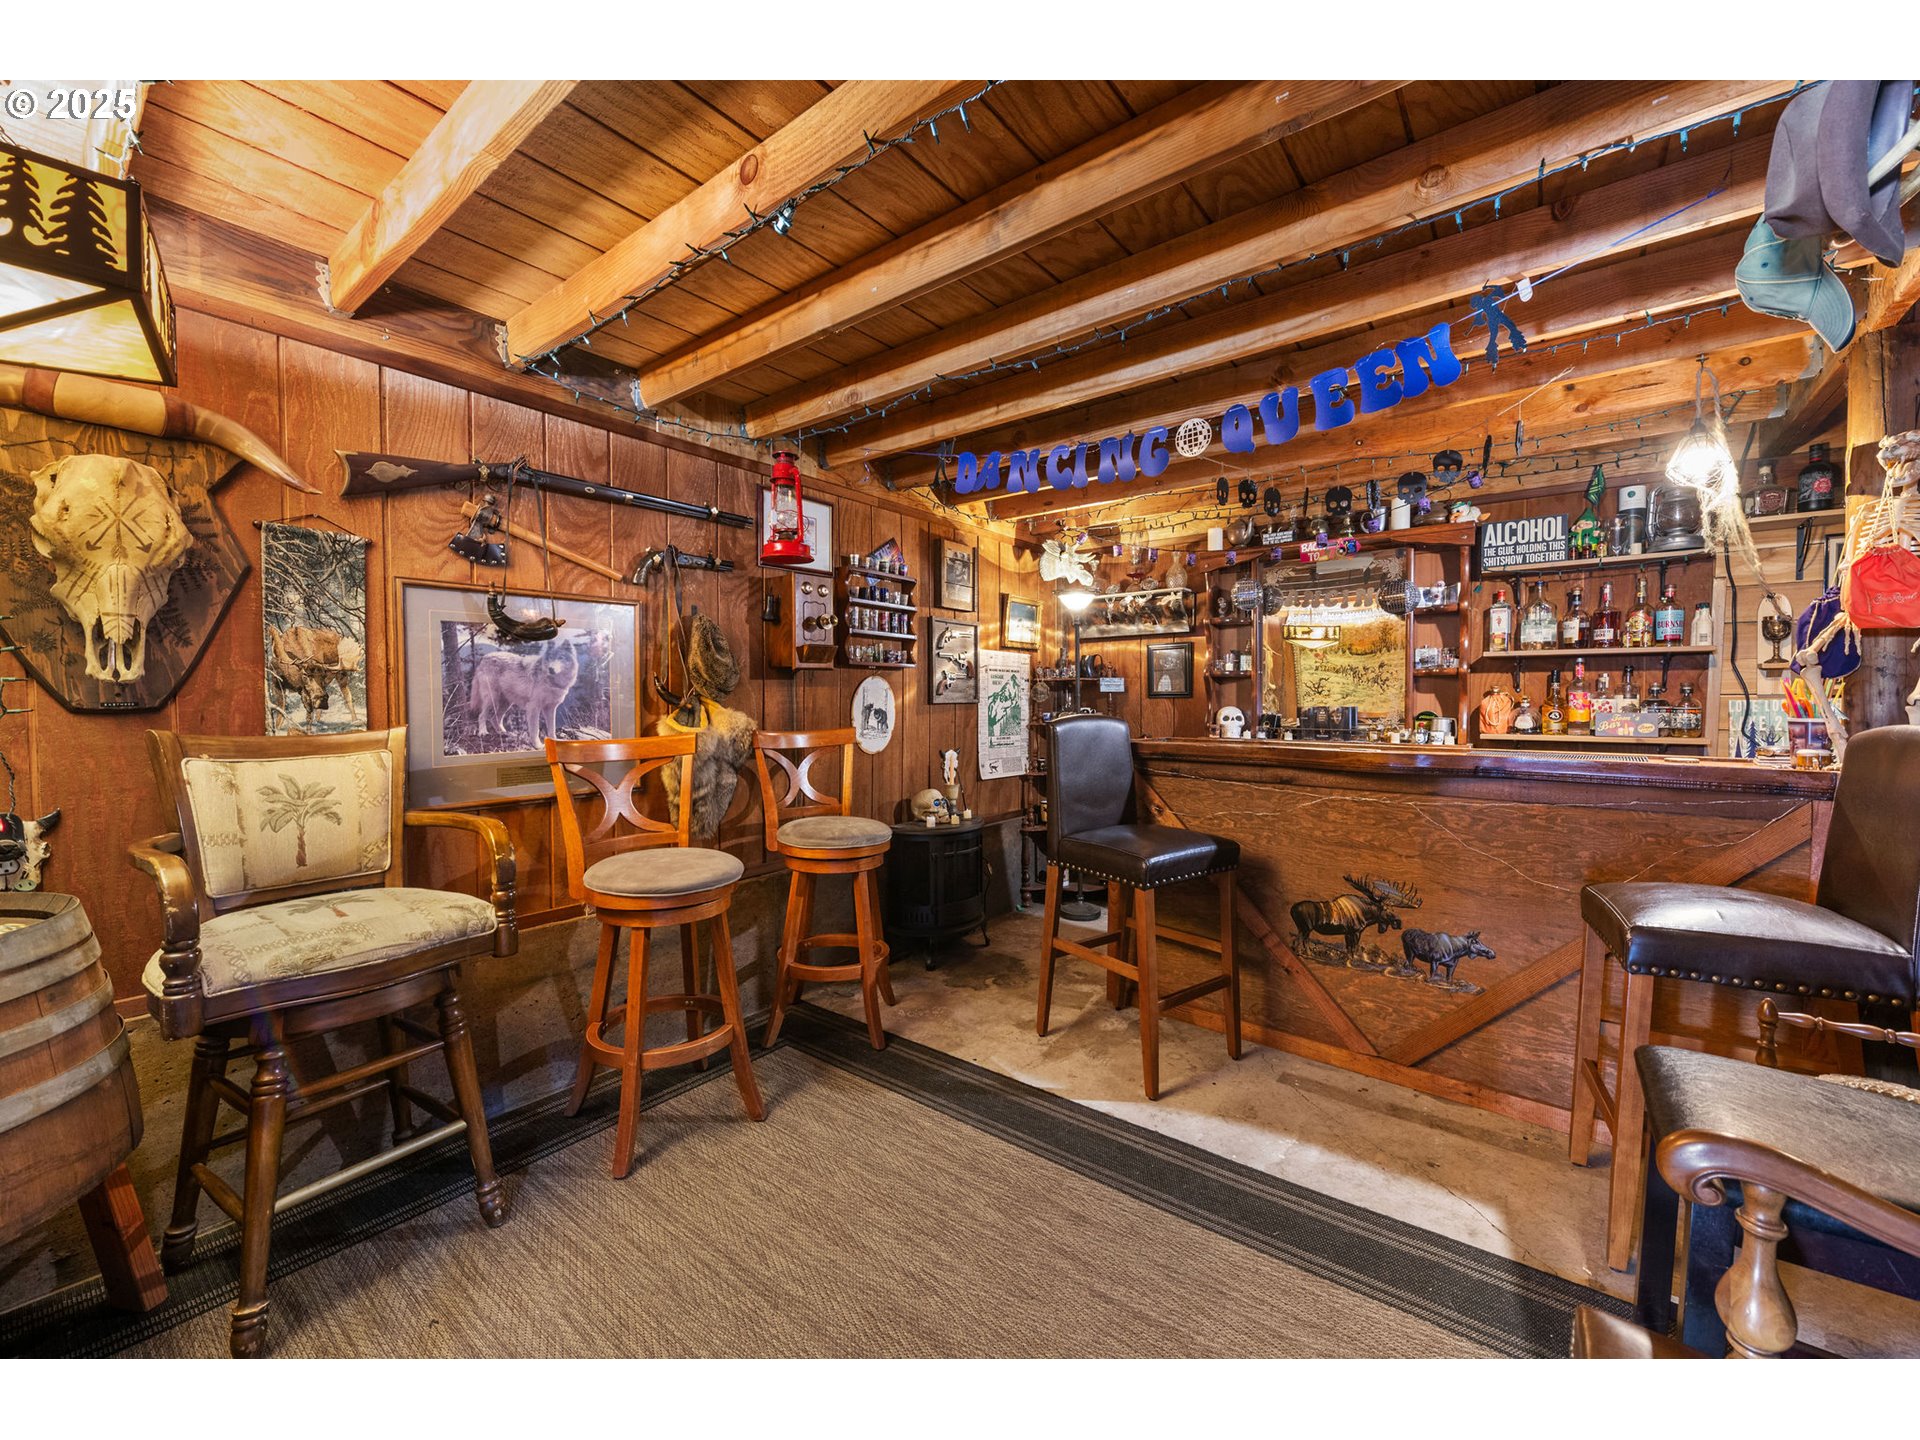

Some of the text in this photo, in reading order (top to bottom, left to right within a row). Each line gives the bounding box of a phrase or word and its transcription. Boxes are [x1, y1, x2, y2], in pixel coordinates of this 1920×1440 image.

[955, 322, 1462, 494] DANCING QUEEN
[1484, 516, 1566, 548] ALCOHOL
[1301, 541, 1327, 553] BAC
[1484, 540, 1566, 557] THE GLUE HOLDING THIS
[1307, 552, 1320, 562] TO
[1483, 551, 1566, 567] SHITSHOW TOGETHER
[1597, 720, 1621, 732] Bar
